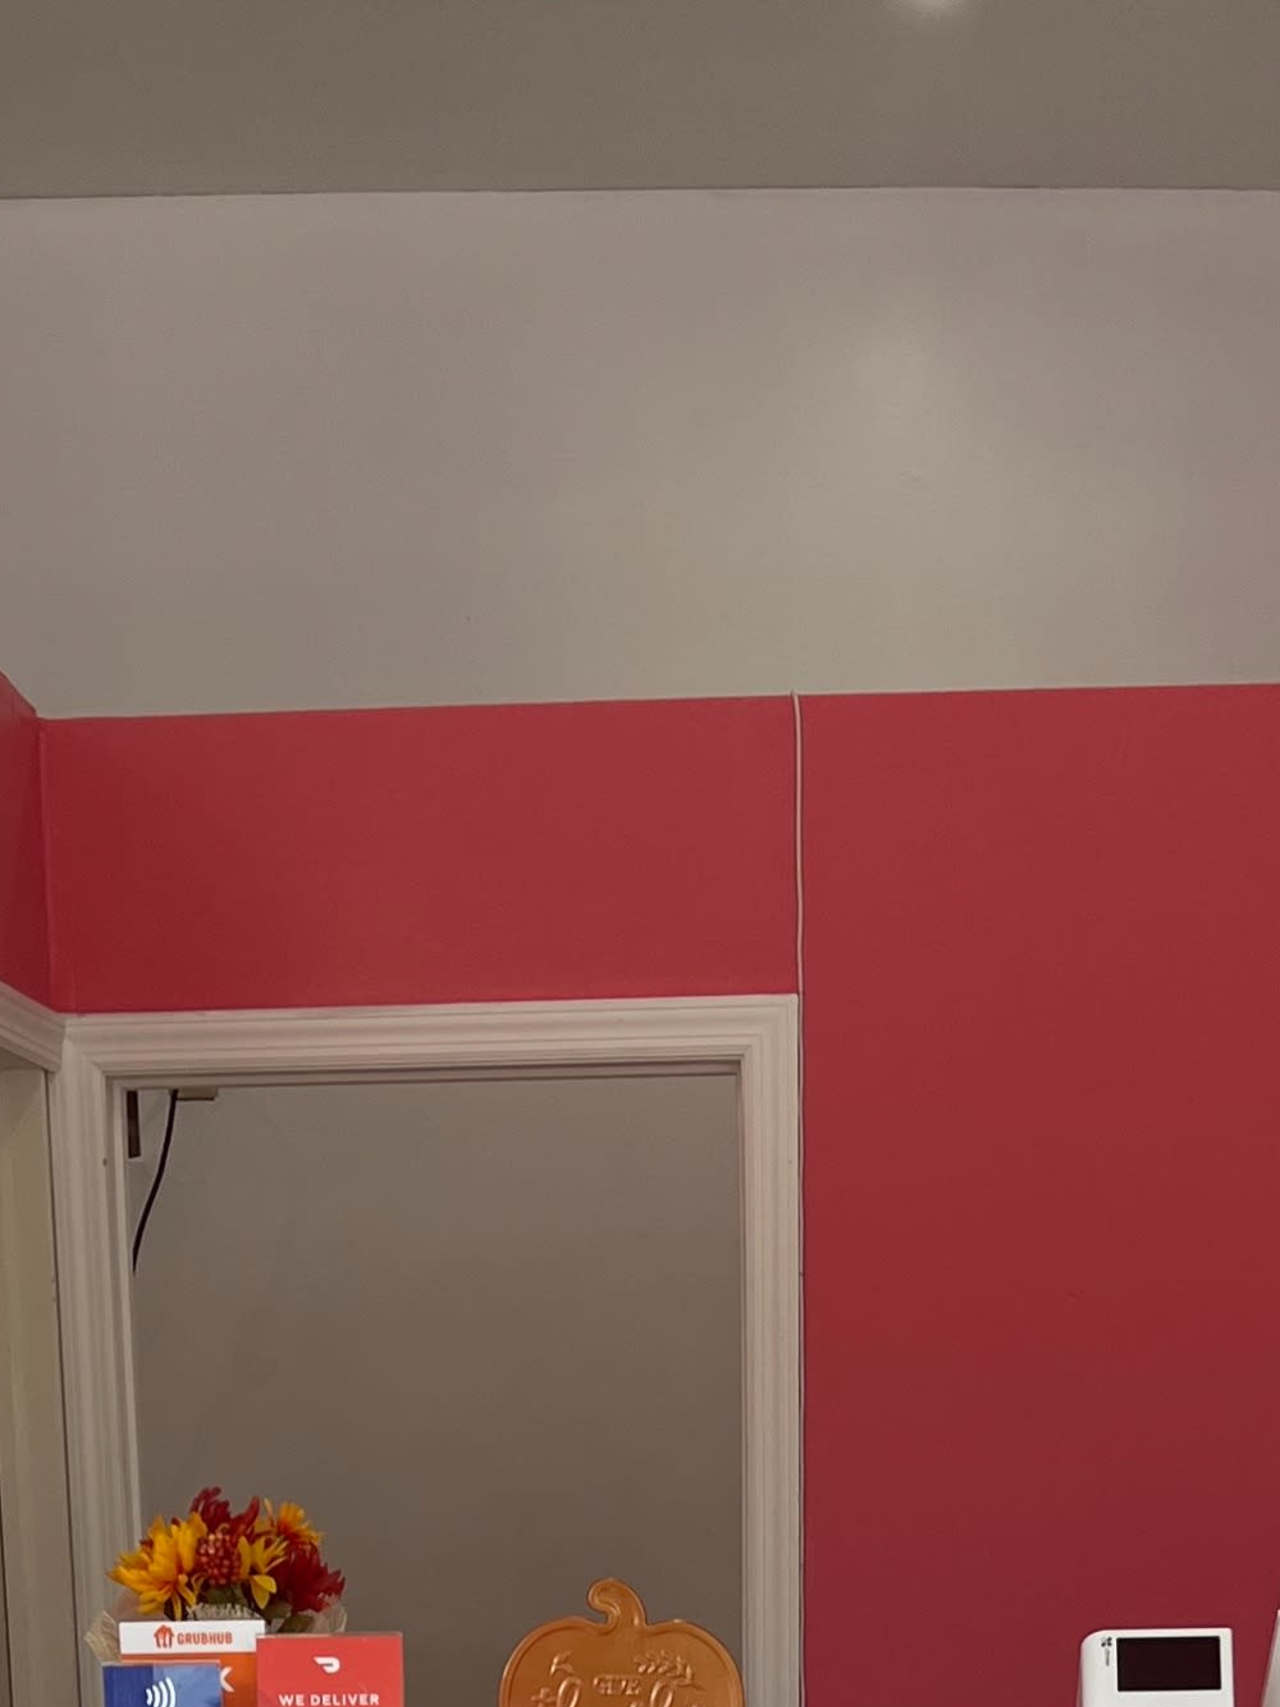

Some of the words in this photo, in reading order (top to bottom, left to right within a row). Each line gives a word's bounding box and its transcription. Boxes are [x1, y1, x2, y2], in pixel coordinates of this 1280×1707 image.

[177, 1631, 233, 1645] GRUBHUB
[278, 1694, 305, 1706] WE
[311, 1693, 380, 1706] DELIVER
